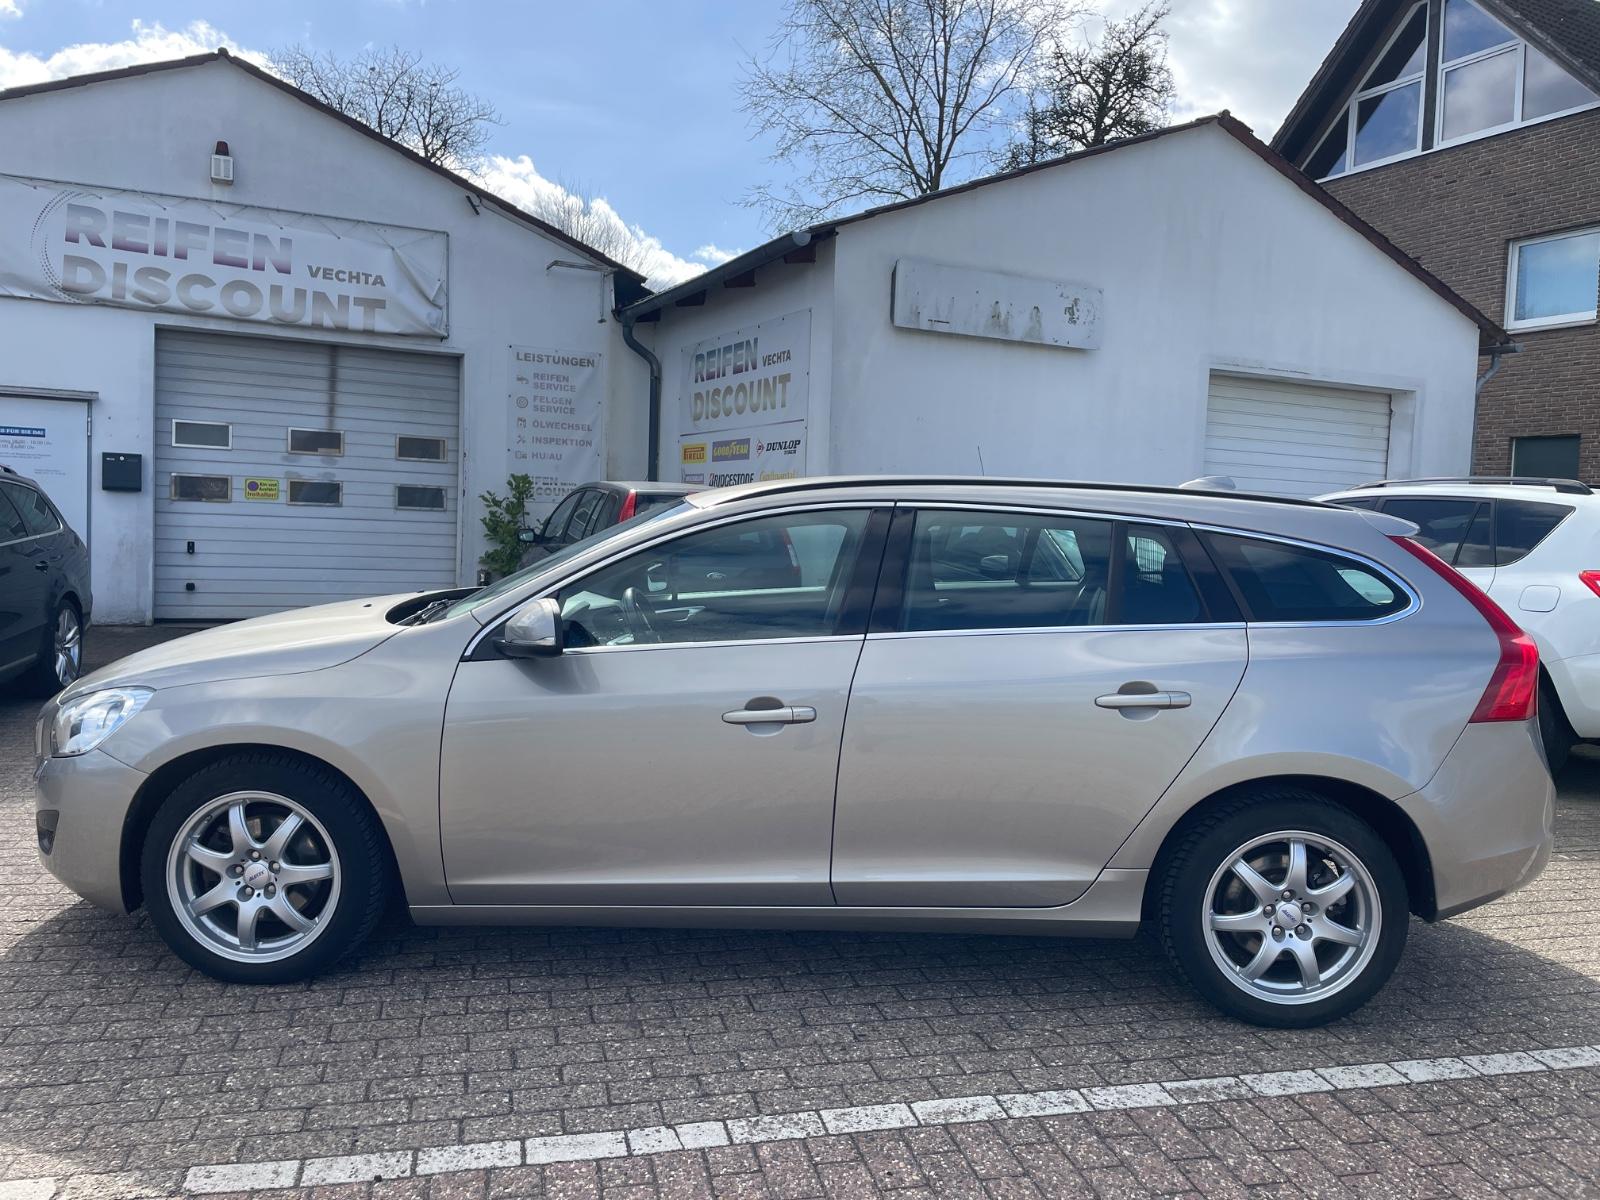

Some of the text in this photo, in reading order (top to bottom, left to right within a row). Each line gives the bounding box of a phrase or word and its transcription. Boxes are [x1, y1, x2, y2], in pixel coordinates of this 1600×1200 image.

[64, 203, 292, 275] REIFEN
[307, 264, 386, 288] VECHTA
[62, 254, 387, 333] DISCOUNT
[516, 351, 595, 368] LEISTUNGEN
[694, 337, 759, 384] REIFEN
[762, 349, 792, 368] VECHTA
[533, 372, 569, 383] REIFEN
[533, 382, 576, 393] SERVICE
[533, 395, 573, 406] FELGEN
[692, 372, 792, 422] DISCOUNT
[533, 404, 576, 415] SERVICE
[531, 435, 593, 448] INSPEKTION
[765, 439, 801, 452] DUNLOP
